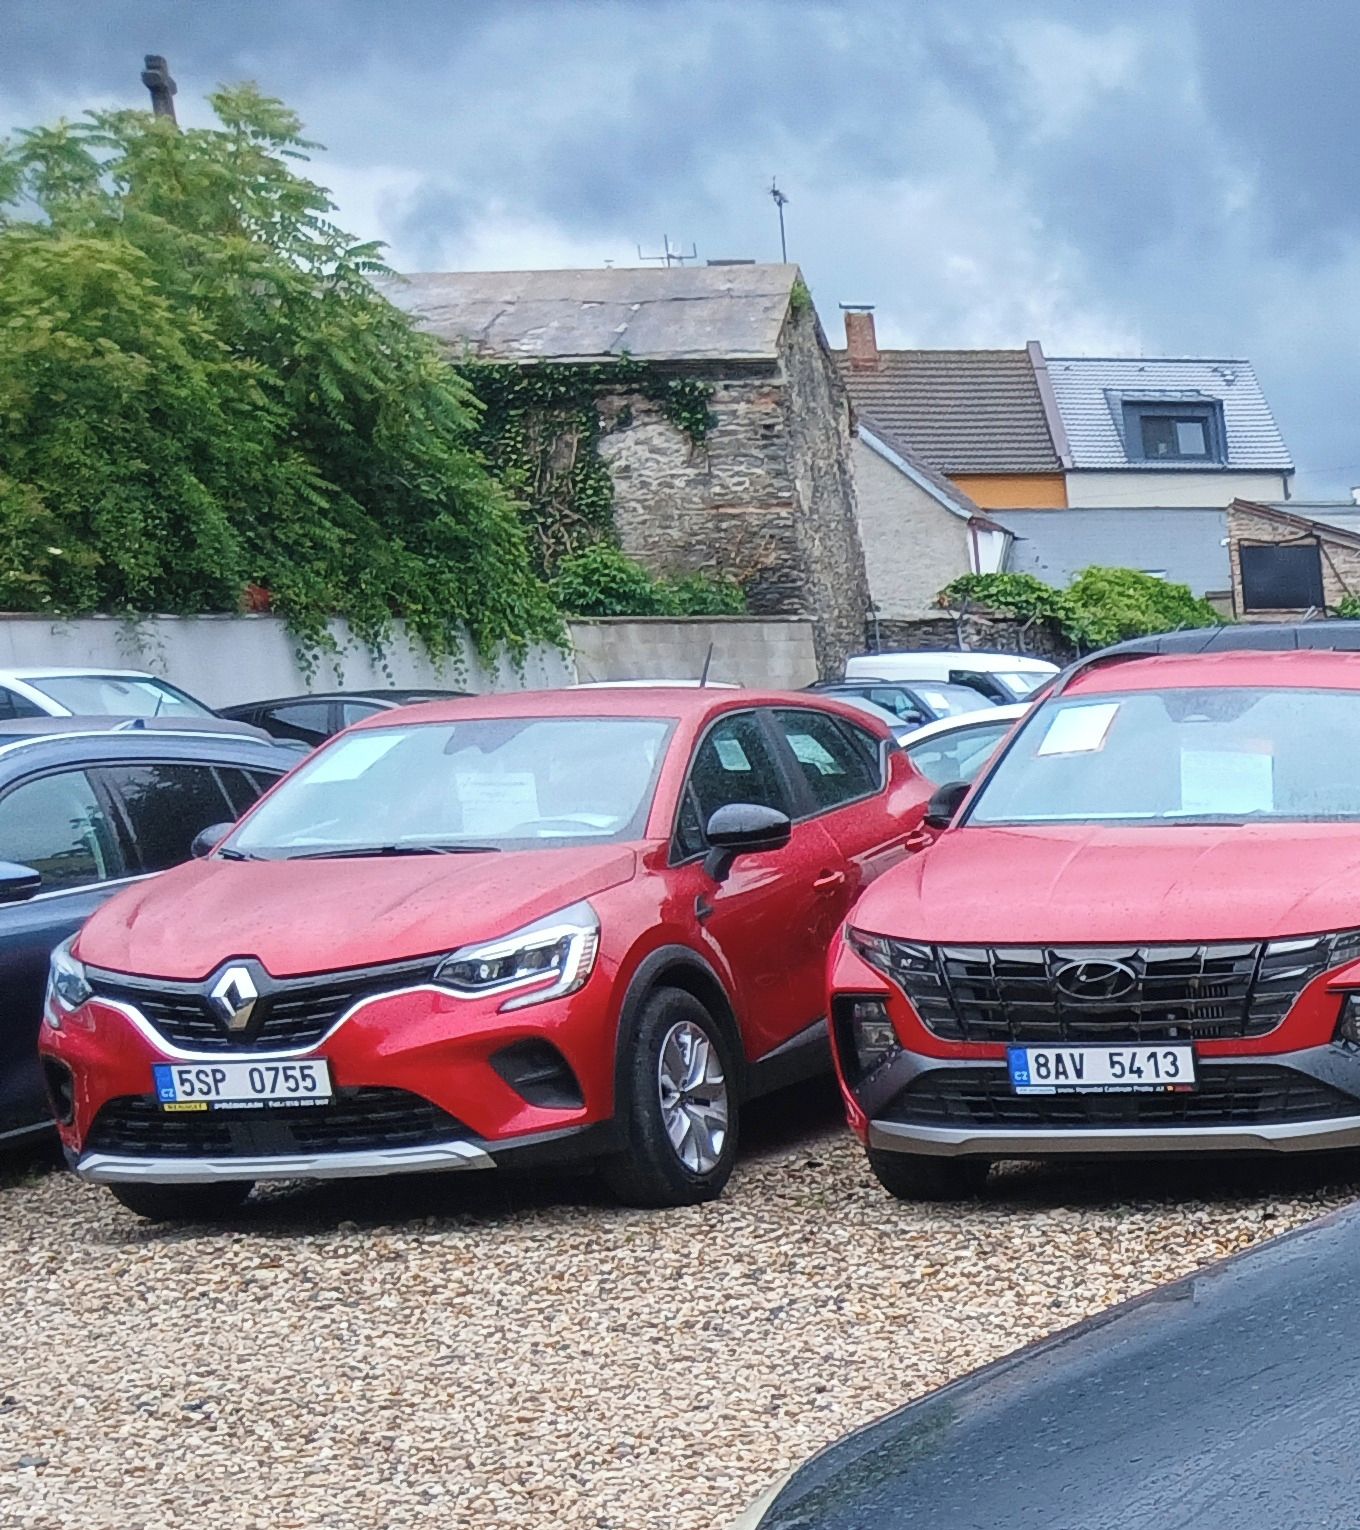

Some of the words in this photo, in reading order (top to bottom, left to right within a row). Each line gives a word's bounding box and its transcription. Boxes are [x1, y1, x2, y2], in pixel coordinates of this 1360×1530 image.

[1014, 1070, 1028, 1081] CZ
[1034, 1052, 1084, 1080] 8AV
[1108, 1051, 1180, 1079] 5413
[177, 1068, 226, 1097] 5SP
[248, 1065, 317, 1094] 0755
[161, 1088, 175, 1098] CZ
